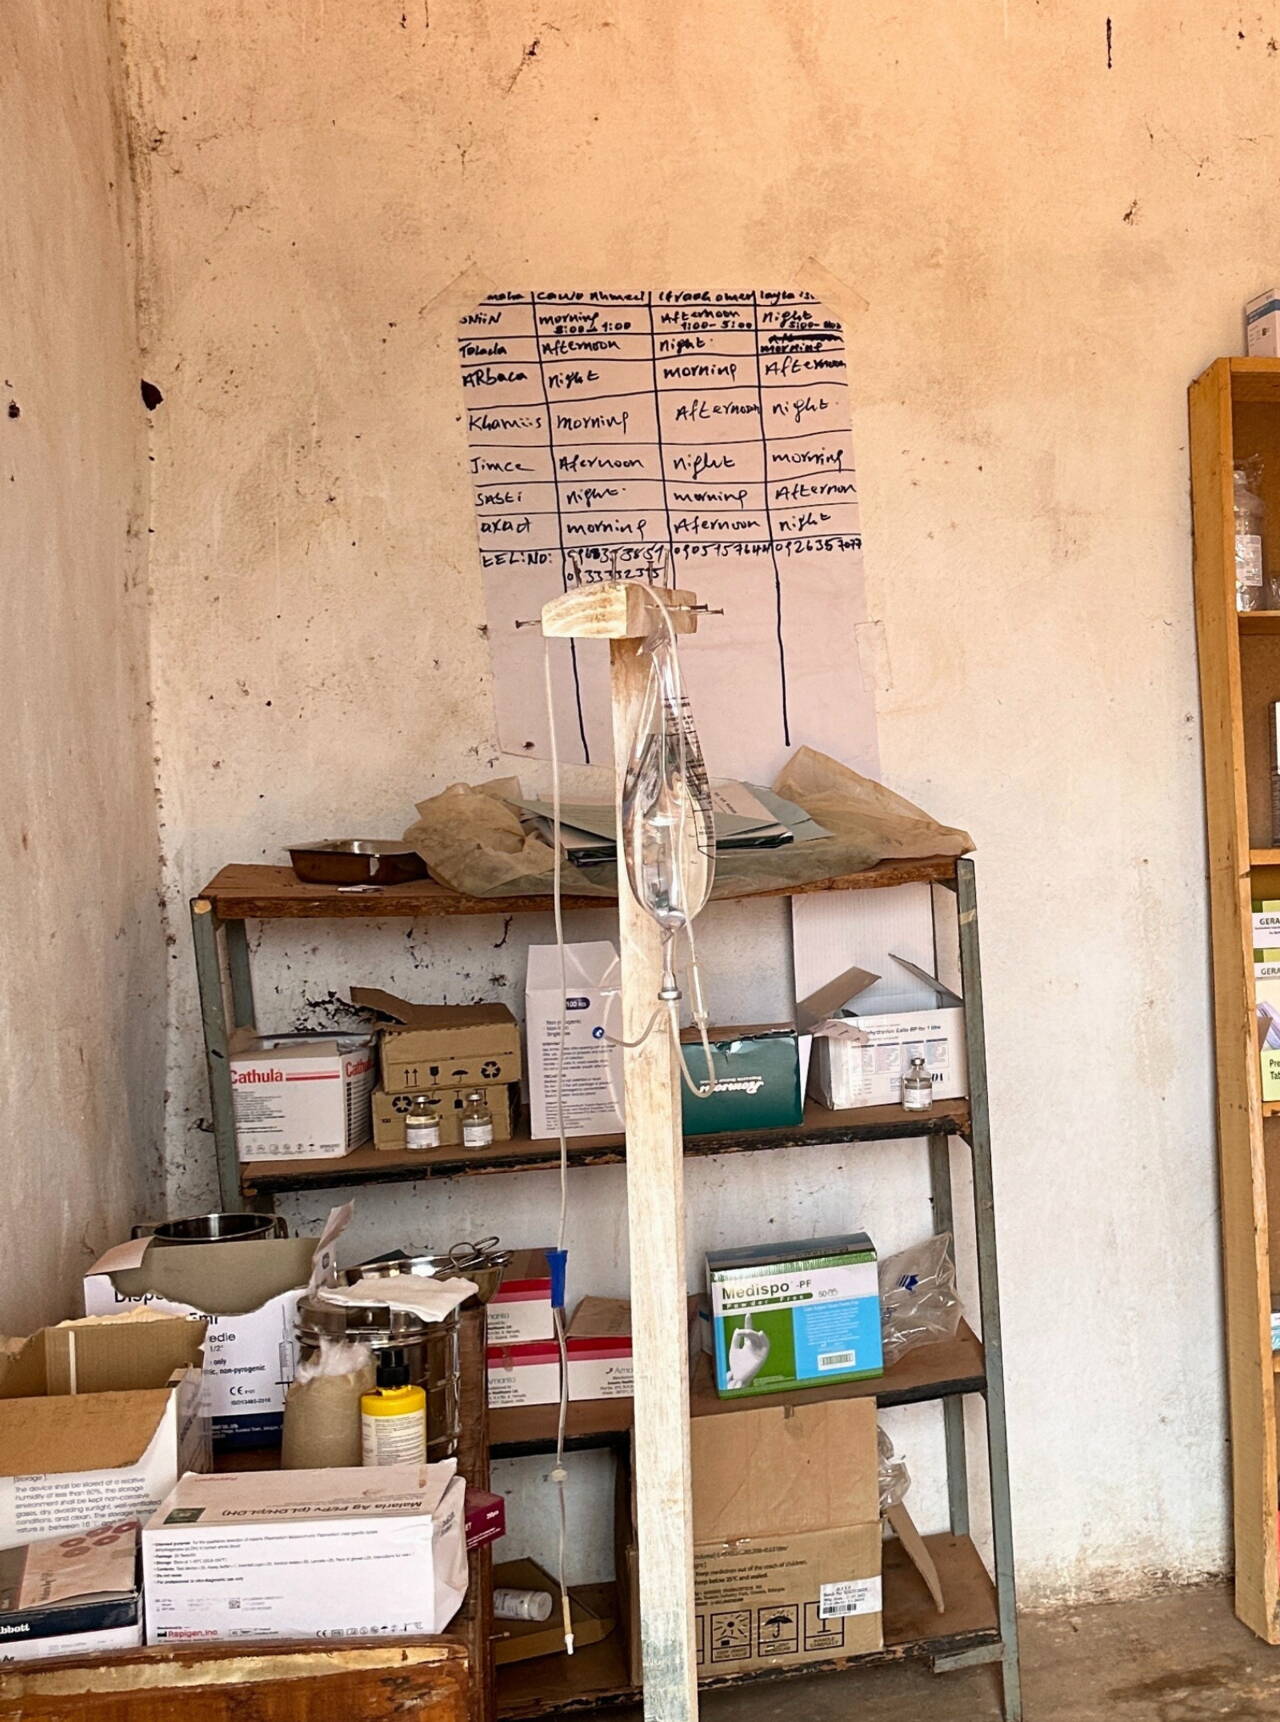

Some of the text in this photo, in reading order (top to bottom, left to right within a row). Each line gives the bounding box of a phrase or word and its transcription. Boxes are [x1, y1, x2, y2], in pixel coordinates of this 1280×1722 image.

[663, 362, 737, 384] morning
[556, 410, 629, 436] morning
[772, 396, 829, 424] night
[672, 451, 736, 481] night
[566, 518, 648, 542] morning
[778, 512, 832, 533] night
[230, 1068, 284, 1085] Cathula
[721, 1280, 791, 1301] Medispo
[351, 1503, 369, 1512] Ag
[374, 1500, 423, 1511] Malaria
[0, 1622, 31, 1636] bbott
